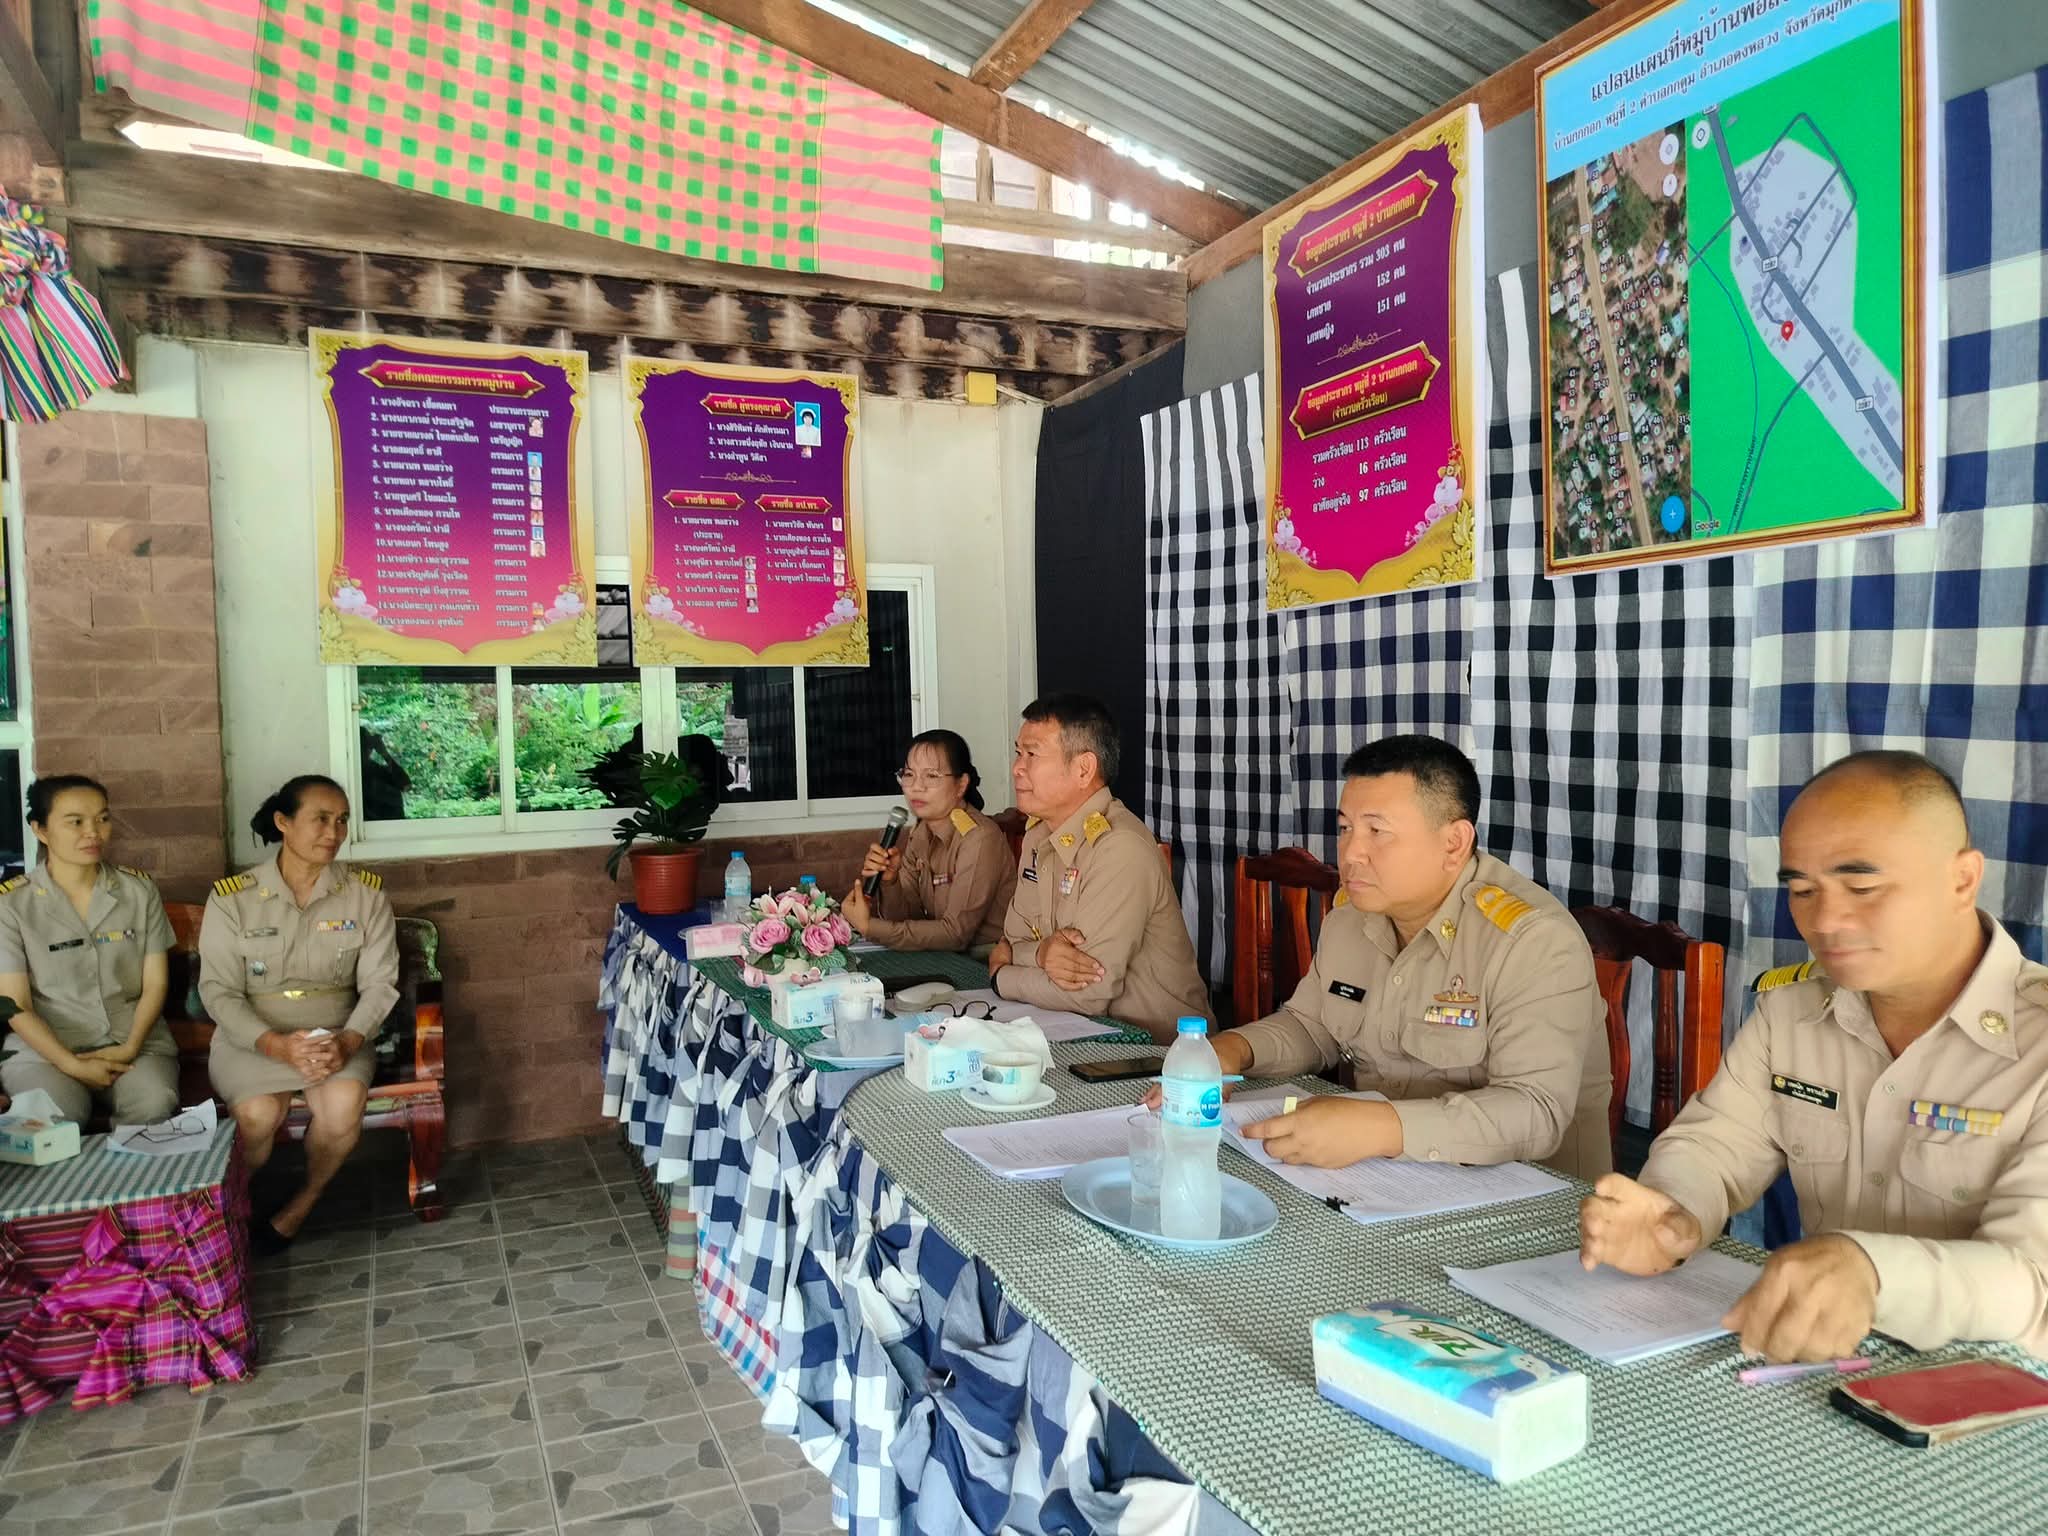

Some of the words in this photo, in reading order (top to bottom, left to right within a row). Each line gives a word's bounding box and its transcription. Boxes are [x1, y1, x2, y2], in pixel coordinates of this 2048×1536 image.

[1605, 102, 1626, 126] หมู่ที่
[1630, 102, 1636, 114] 2
[1640, 73, 1695, 110] ตำบลกกตูม
[1352, 209, 1368, 240] หมู่ที่
[1370, 213, 1374, 228] 2
[1306, 262, 1358, 296] จำนวนประชากร
[1360, 253, 1374, 270] รวม
[1376, 244, 1390, 264] 303
[1394, 238, 1406, 254] คน
[1306, 302, 1332, 320] เพศชาย
[1376, 270, 1390, 288] 152
[1394, 264, 1406, 280] คน
[1306, 322, 1334, 345] เพศหญิง
[1377, 297, 1390, 314] 151
[1394, 291, 1406, 307] คน
[1308, 384, 1352, 410] ข้อมูลประชากร
[1354, 370, 1370, 394] หมู่ที่
[1371, 374, 1376, 386] 2
[371, 396, 378, 405] 1.
[371, 412, 379, 421] 2.
[709, 422, 714, 430] 1.
[372, 428, 380, 436] 3.
[708, 436, 716, 444] 2.
[1312, 438, 1354, 464] รวมครัวเรือน
[1356, 438, 1370, 454] 113
[1374, 425, 1407, 446] ครัวเรือน
[372, 444, 380, 452] 4.
[710, 452, 716, 460] 3.
[1312, 472, 1326, 488] ว่าง
[1358, 461, 1368, 475] 16
[1374, 452, 1407, 472] ครัวเรือน
[1358, 488, 1369, 502] 97
[1374, 478, 1407, 498] ครัวเรือน
[374, 492, 381, 500] 7.
[674, 516, 680, 524] 1.
[766, 520, 770, 528] 1.
